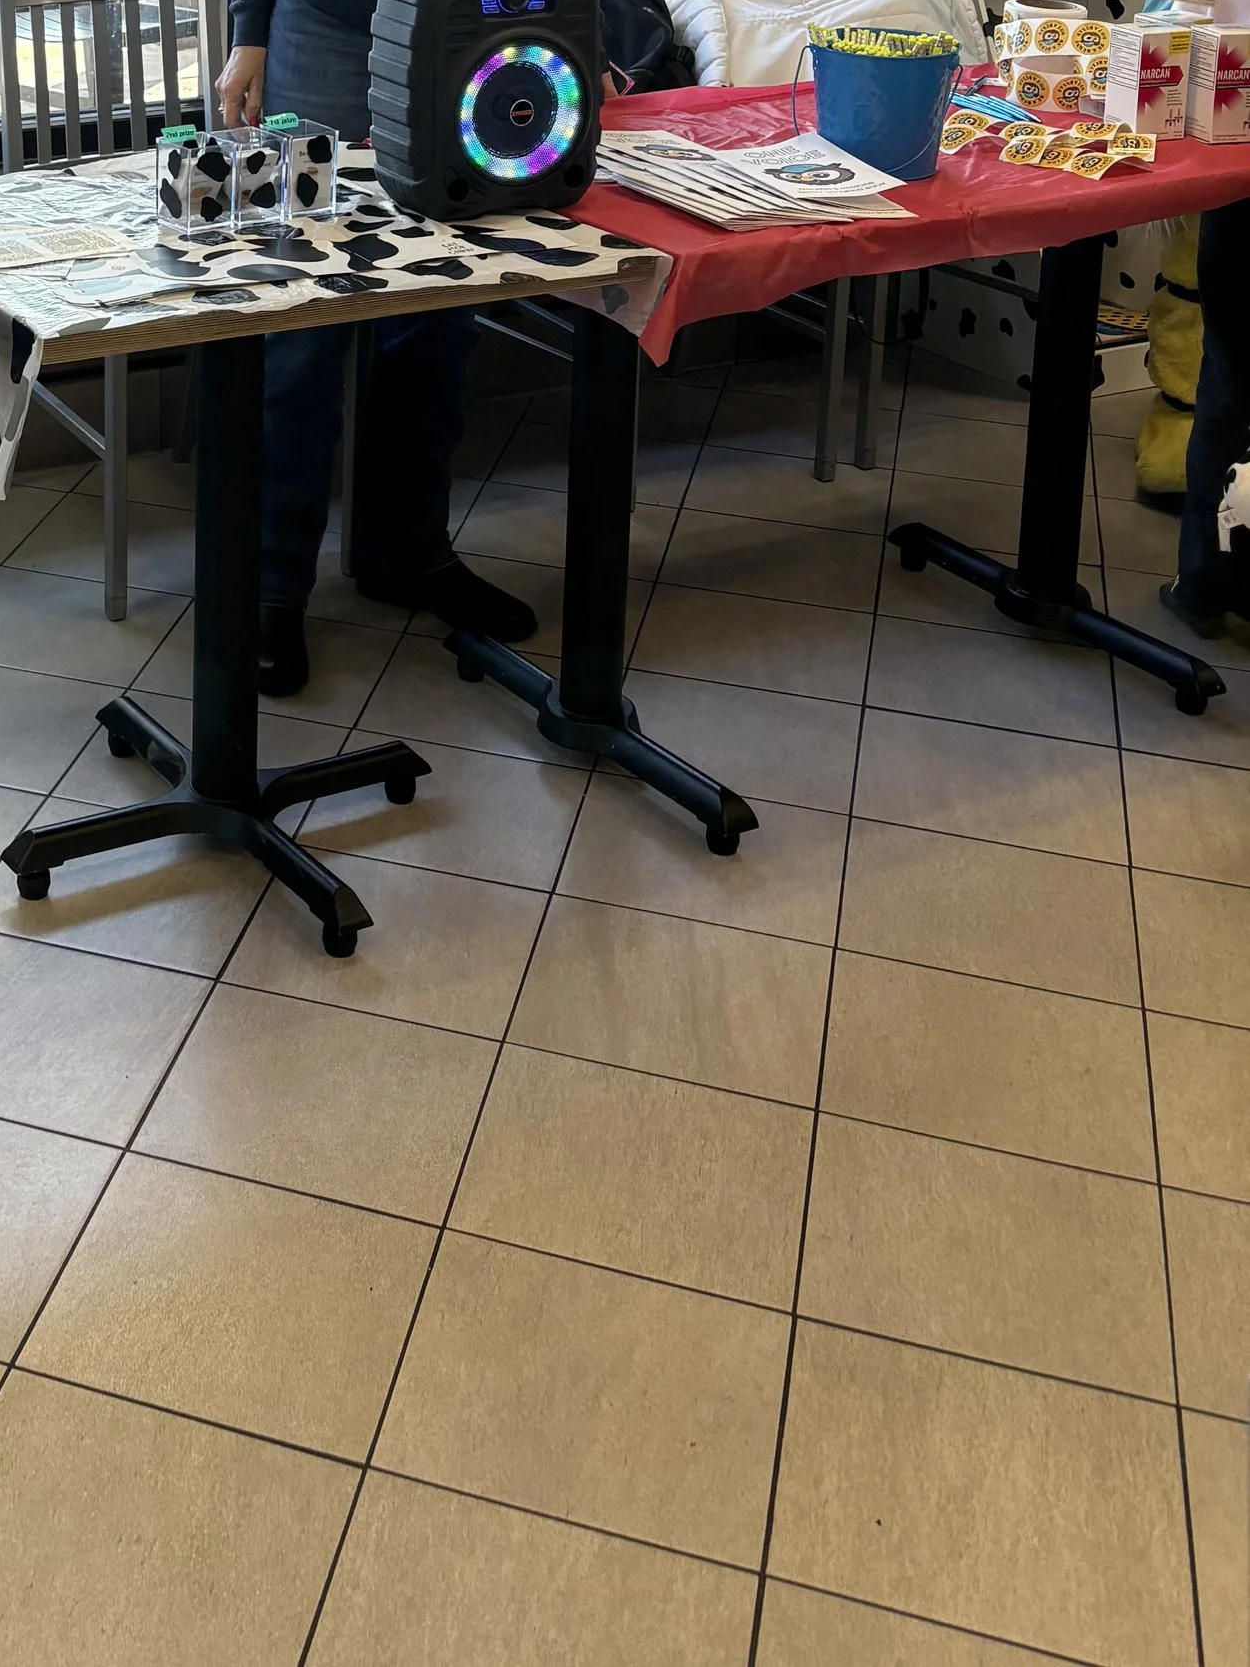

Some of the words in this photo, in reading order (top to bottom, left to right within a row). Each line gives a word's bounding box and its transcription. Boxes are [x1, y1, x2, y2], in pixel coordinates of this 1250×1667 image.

[1140, 67, 1171, 80] NARCAN
[1217, 69, 1250, 81] NARCAN
[166, 131, 178, 139] 2nd
[740, 149, 826, 166] VOICE
[743, 145, 800, 159] ONE
